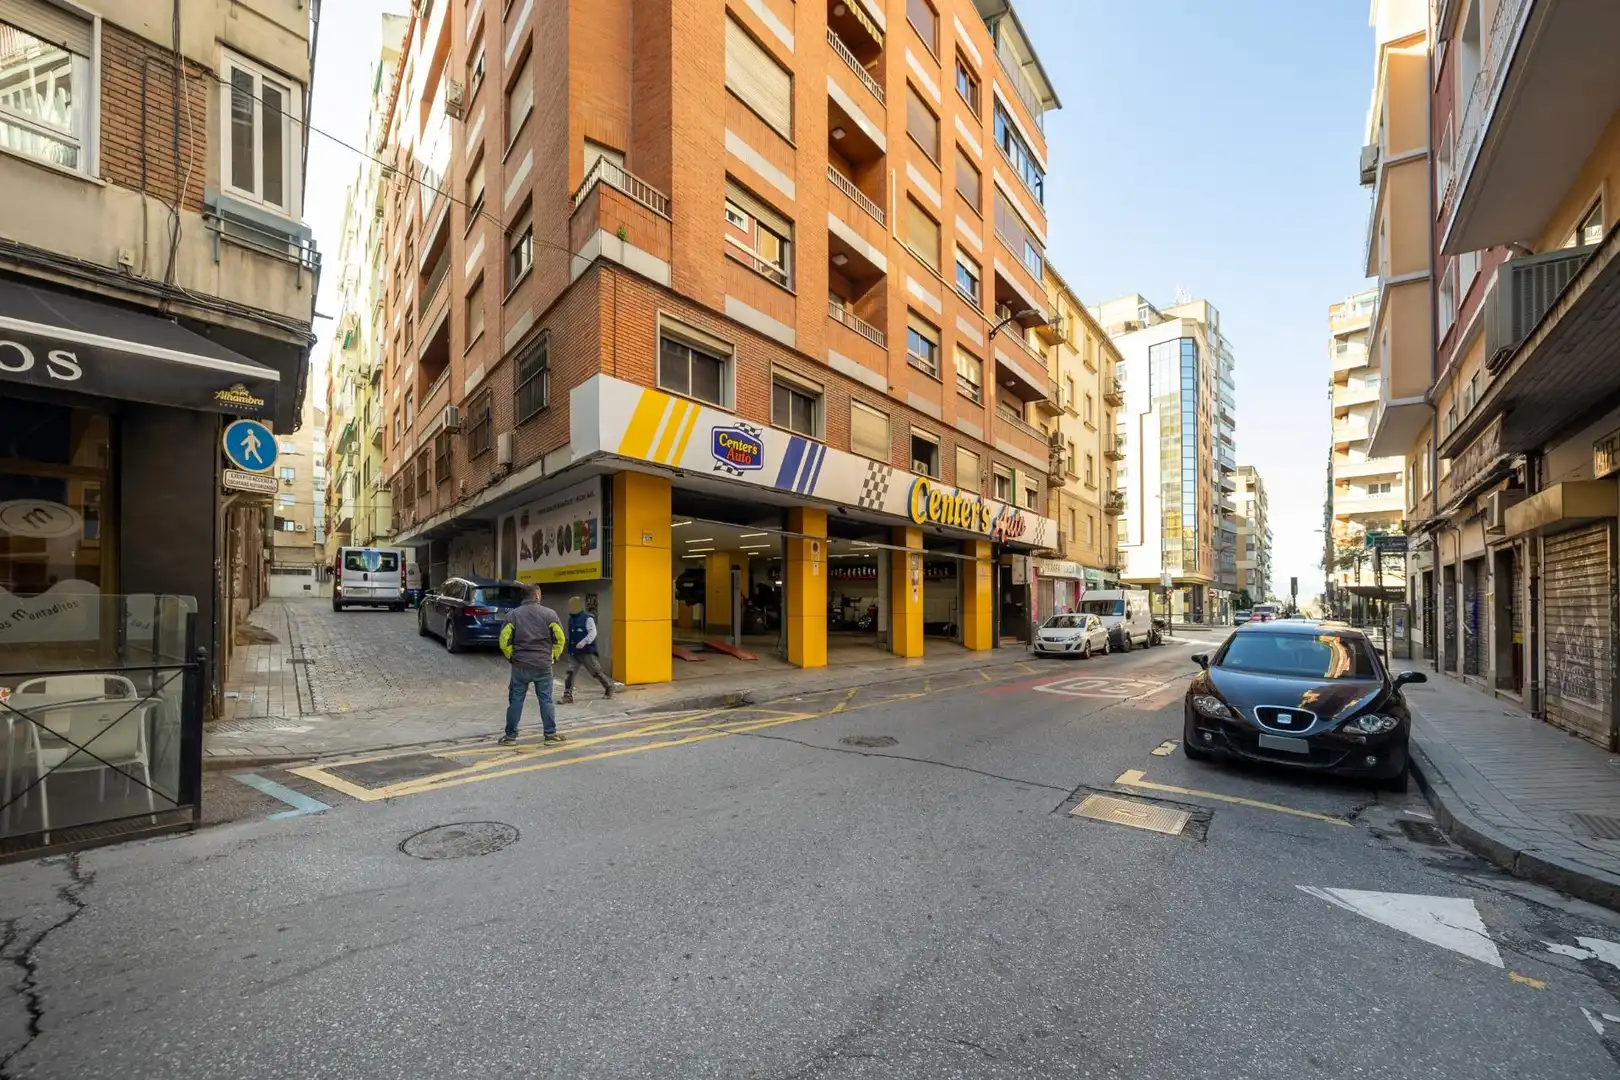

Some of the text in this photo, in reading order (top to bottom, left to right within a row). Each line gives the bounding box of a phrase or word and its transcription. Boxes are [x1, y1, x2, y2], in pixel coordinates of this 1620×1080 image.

[214, 390, 264, 406] Alhambra
[719, 433, 758, 455] Center's
[726, 447, 752, 464] Auto
[908, 476, 1026, 543] Center's Auto
